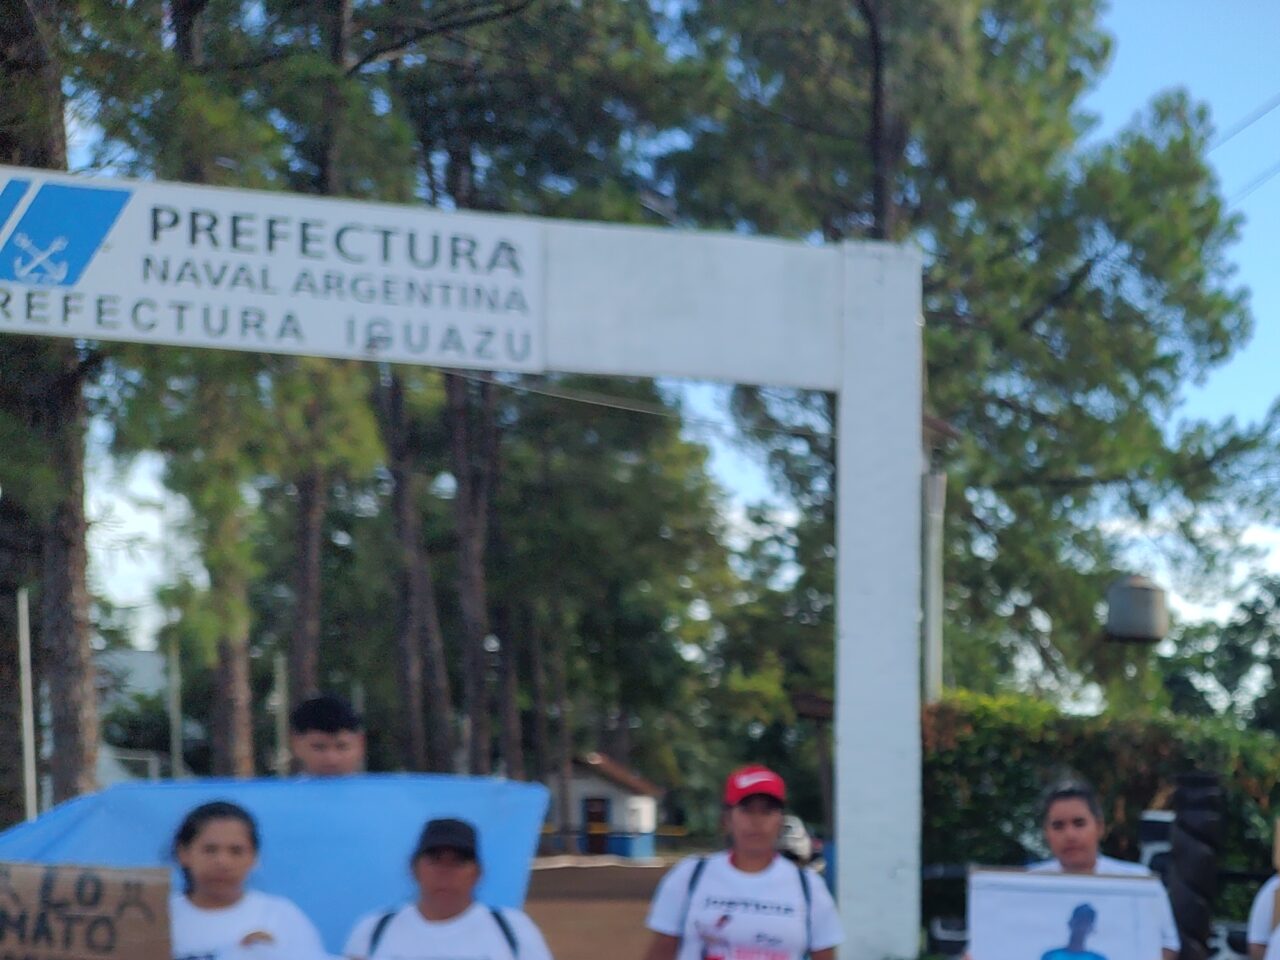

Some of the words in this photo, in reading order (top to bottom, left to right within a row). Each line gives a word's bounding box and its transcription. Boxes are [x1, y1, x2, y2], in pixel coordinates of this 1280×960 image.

[150, 205, 523, 277] PREFECTURA
[141, 256, 278, 297] NAVAL
[293, 271, 532, 316] ARGENTINA
[345, 316, 533, 363] IGUAZU
